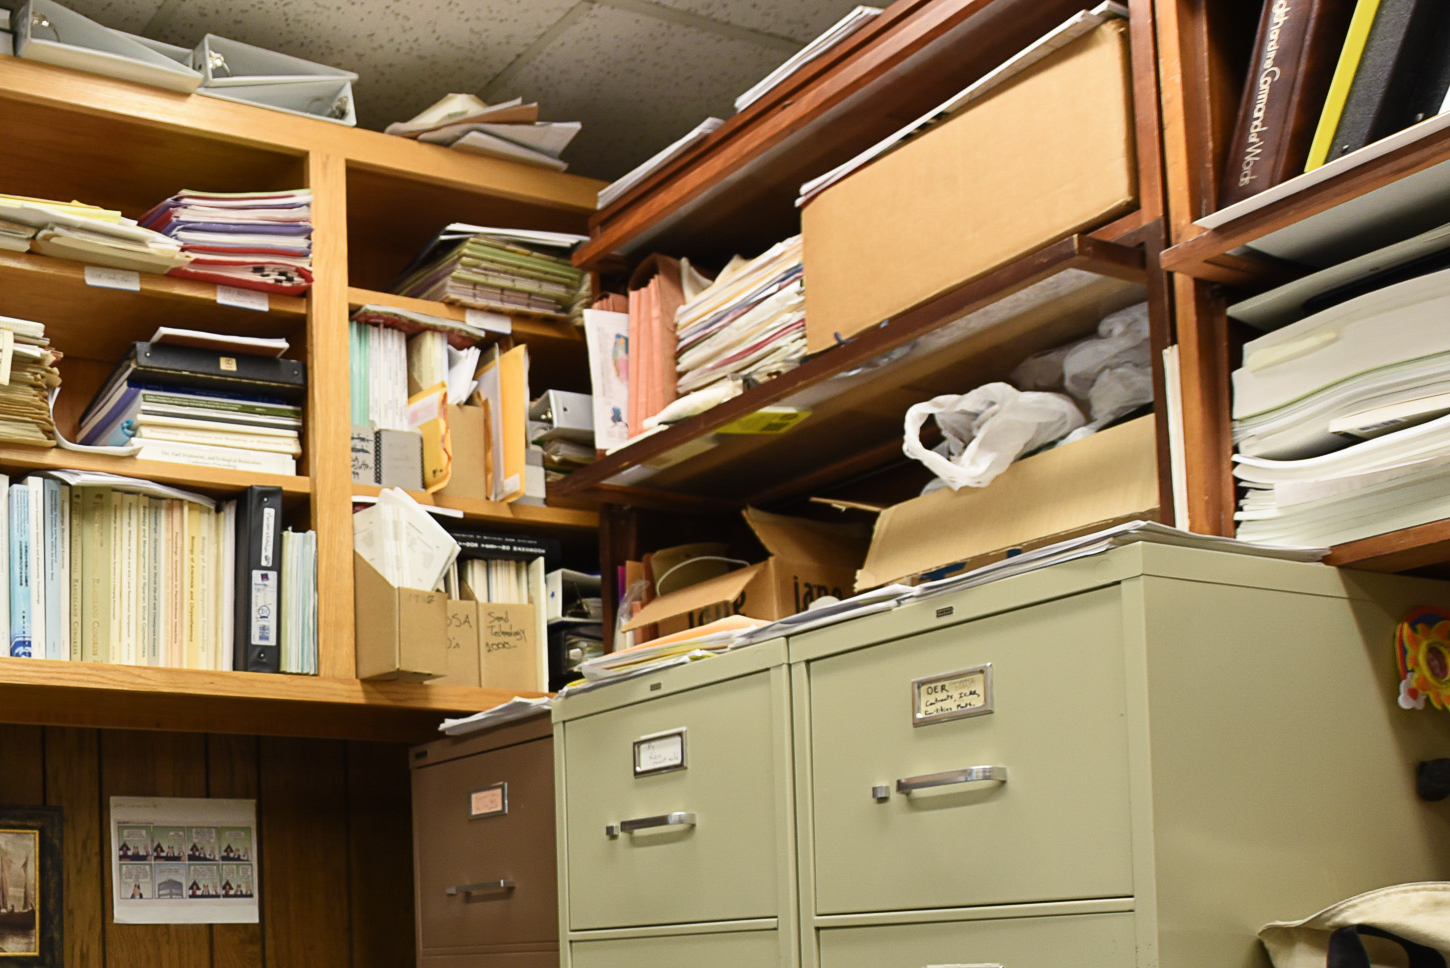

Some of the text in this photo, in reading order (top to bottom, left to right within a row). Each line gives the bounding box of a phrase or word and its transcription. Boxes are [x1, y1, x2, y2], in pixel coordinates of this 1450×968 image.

[71, 578, 79, 618] RANGELAND
[90, 578, 101, 657] RANGELAND CONGRESS
[486, 623, 527, 642] Technology
[71, 621, 80, 656] CONGRESS
